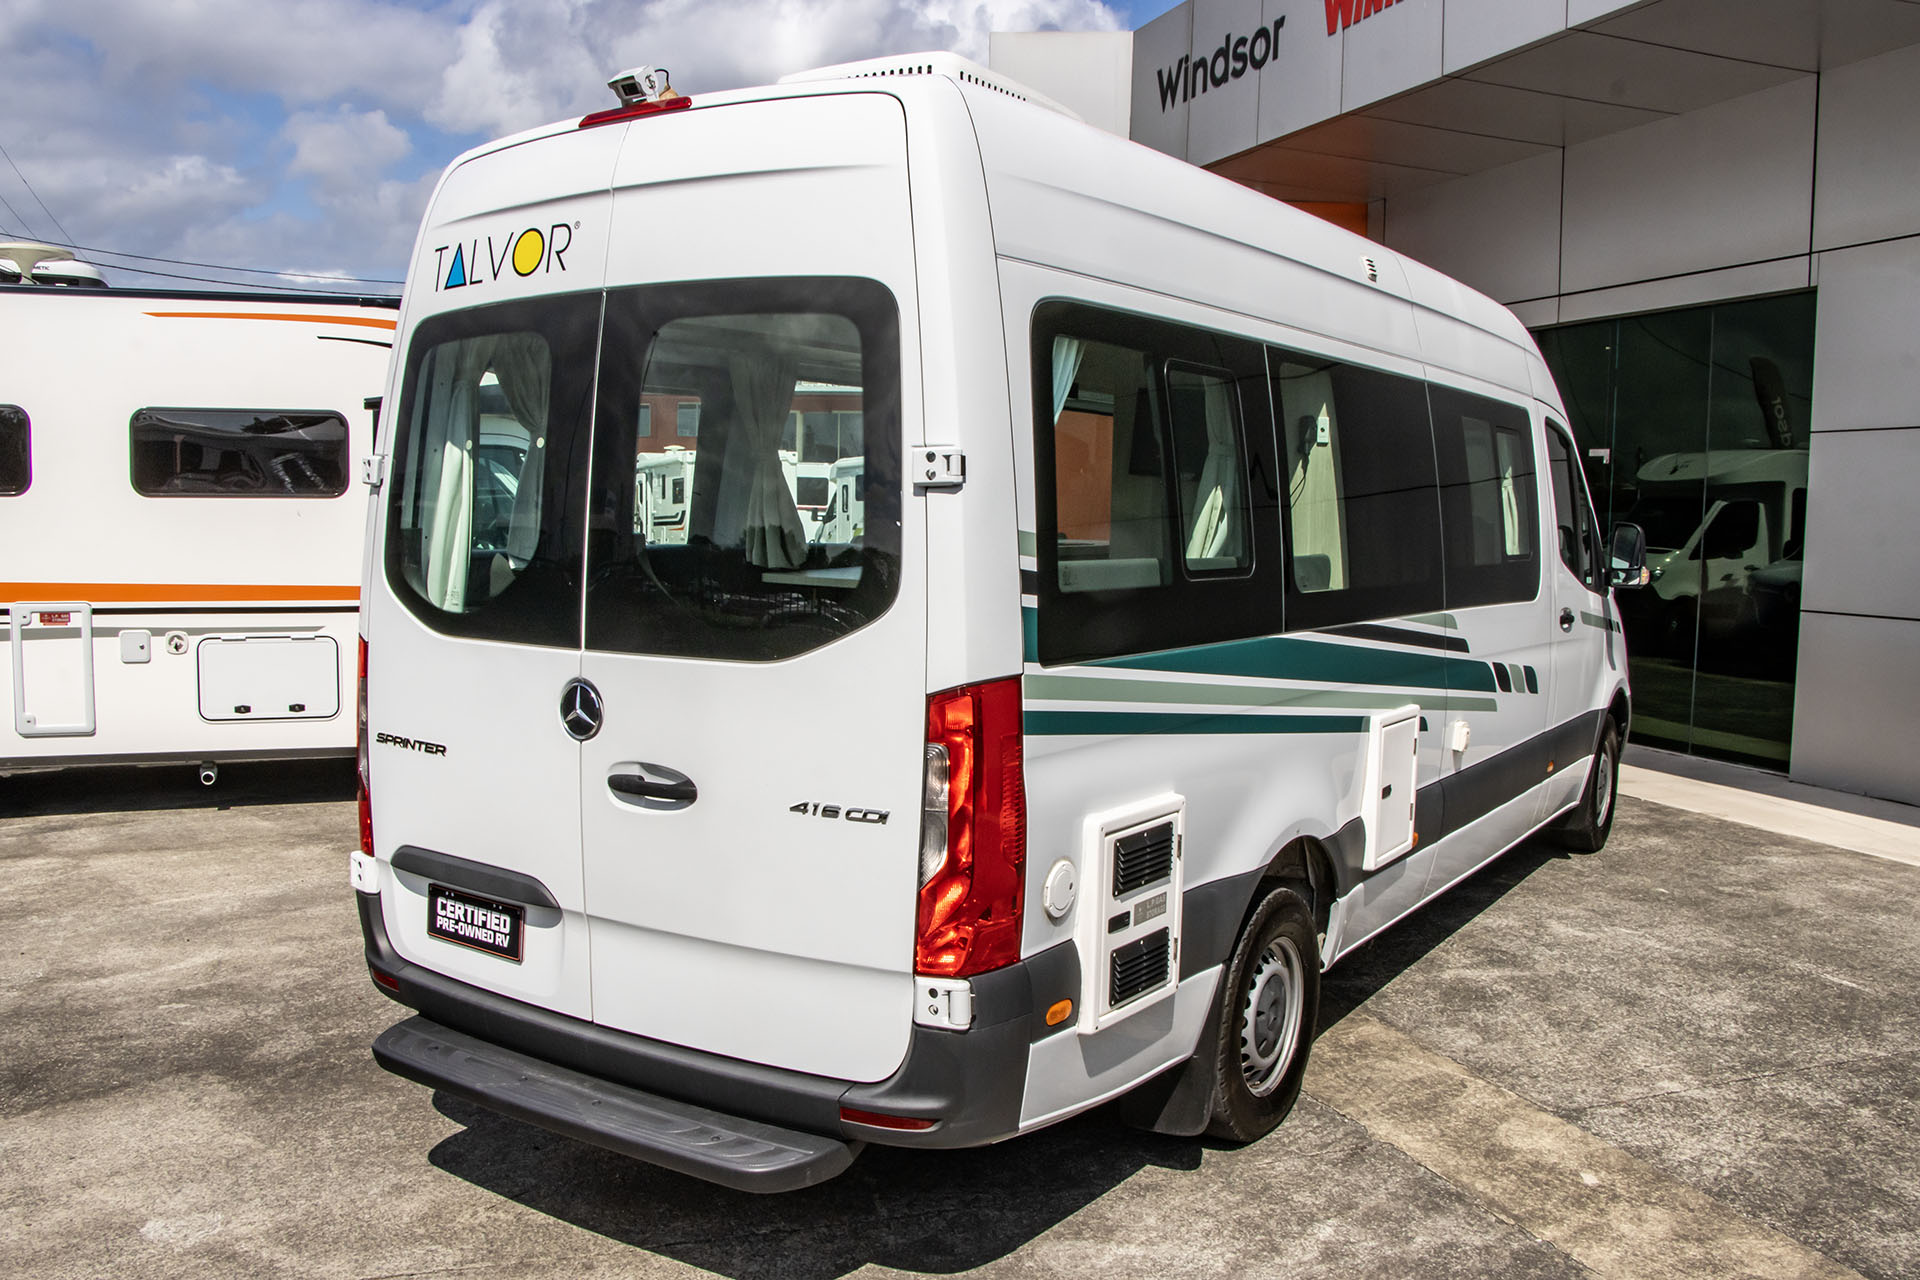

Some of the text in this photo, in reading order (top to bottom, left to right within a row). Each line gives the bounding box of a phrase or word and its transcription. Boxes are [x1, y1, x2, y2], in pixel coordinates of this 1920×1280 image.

[1157, 15, 1286, 113] Windsor
[376, 732, 447, 757] SPRINTER
[789, 801, 841, 819] 416
[436, 896, 511, 934] CERTIFIED
[436, 915, 510, 948] PRE-OWNED RV
